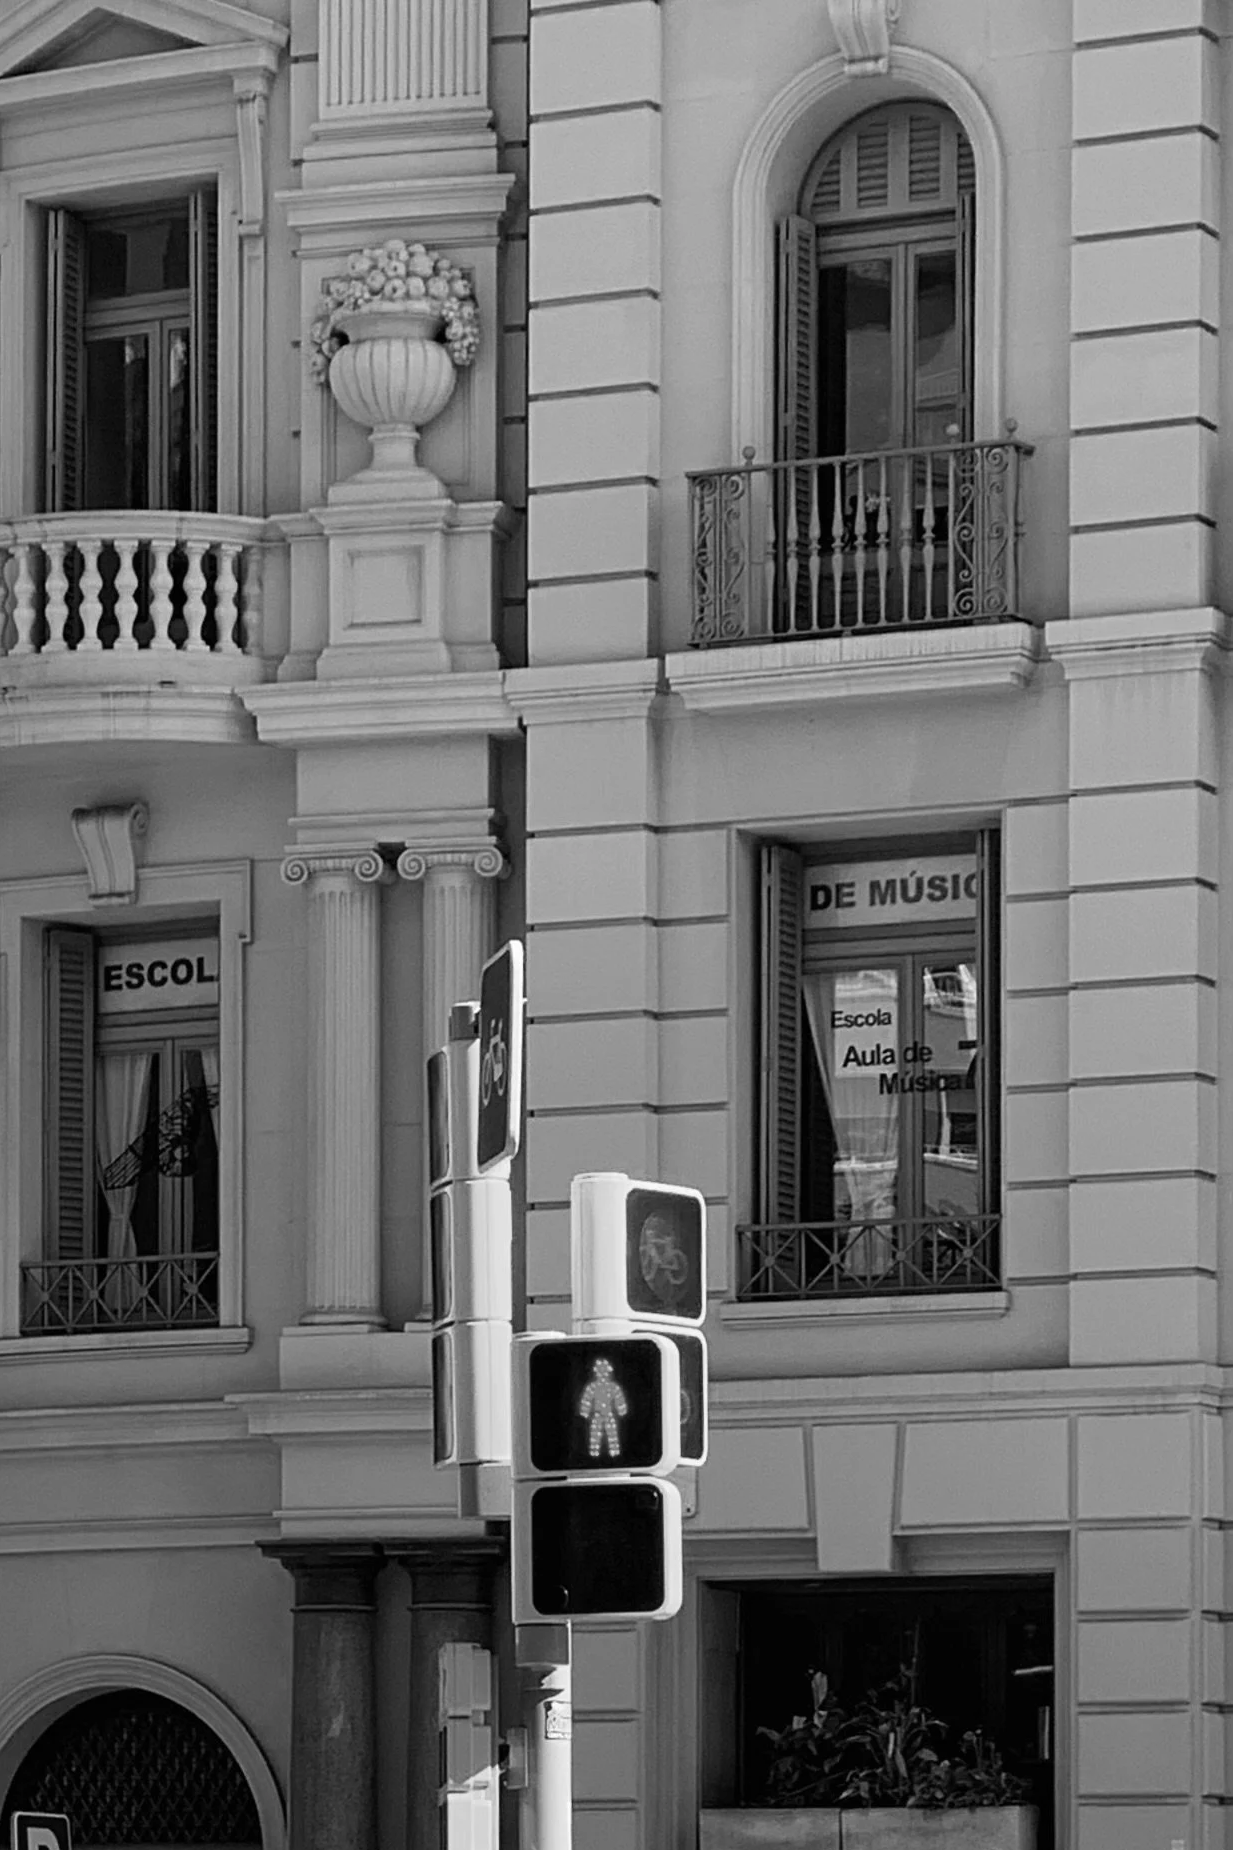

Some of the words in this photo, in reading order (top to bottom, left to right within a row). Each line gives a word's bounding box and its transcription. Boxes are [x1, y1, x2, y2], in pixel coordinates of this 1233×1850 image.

[810, 881, 856, 911] DE
[103, 956, 219, 992] ESCOL
[830, 1008, 892, 1029] Escola
[842, 1043, 896, 1068] Aula
[903, 1040, 933, 1064] de
[879, 1070, 962, 1095] Música
